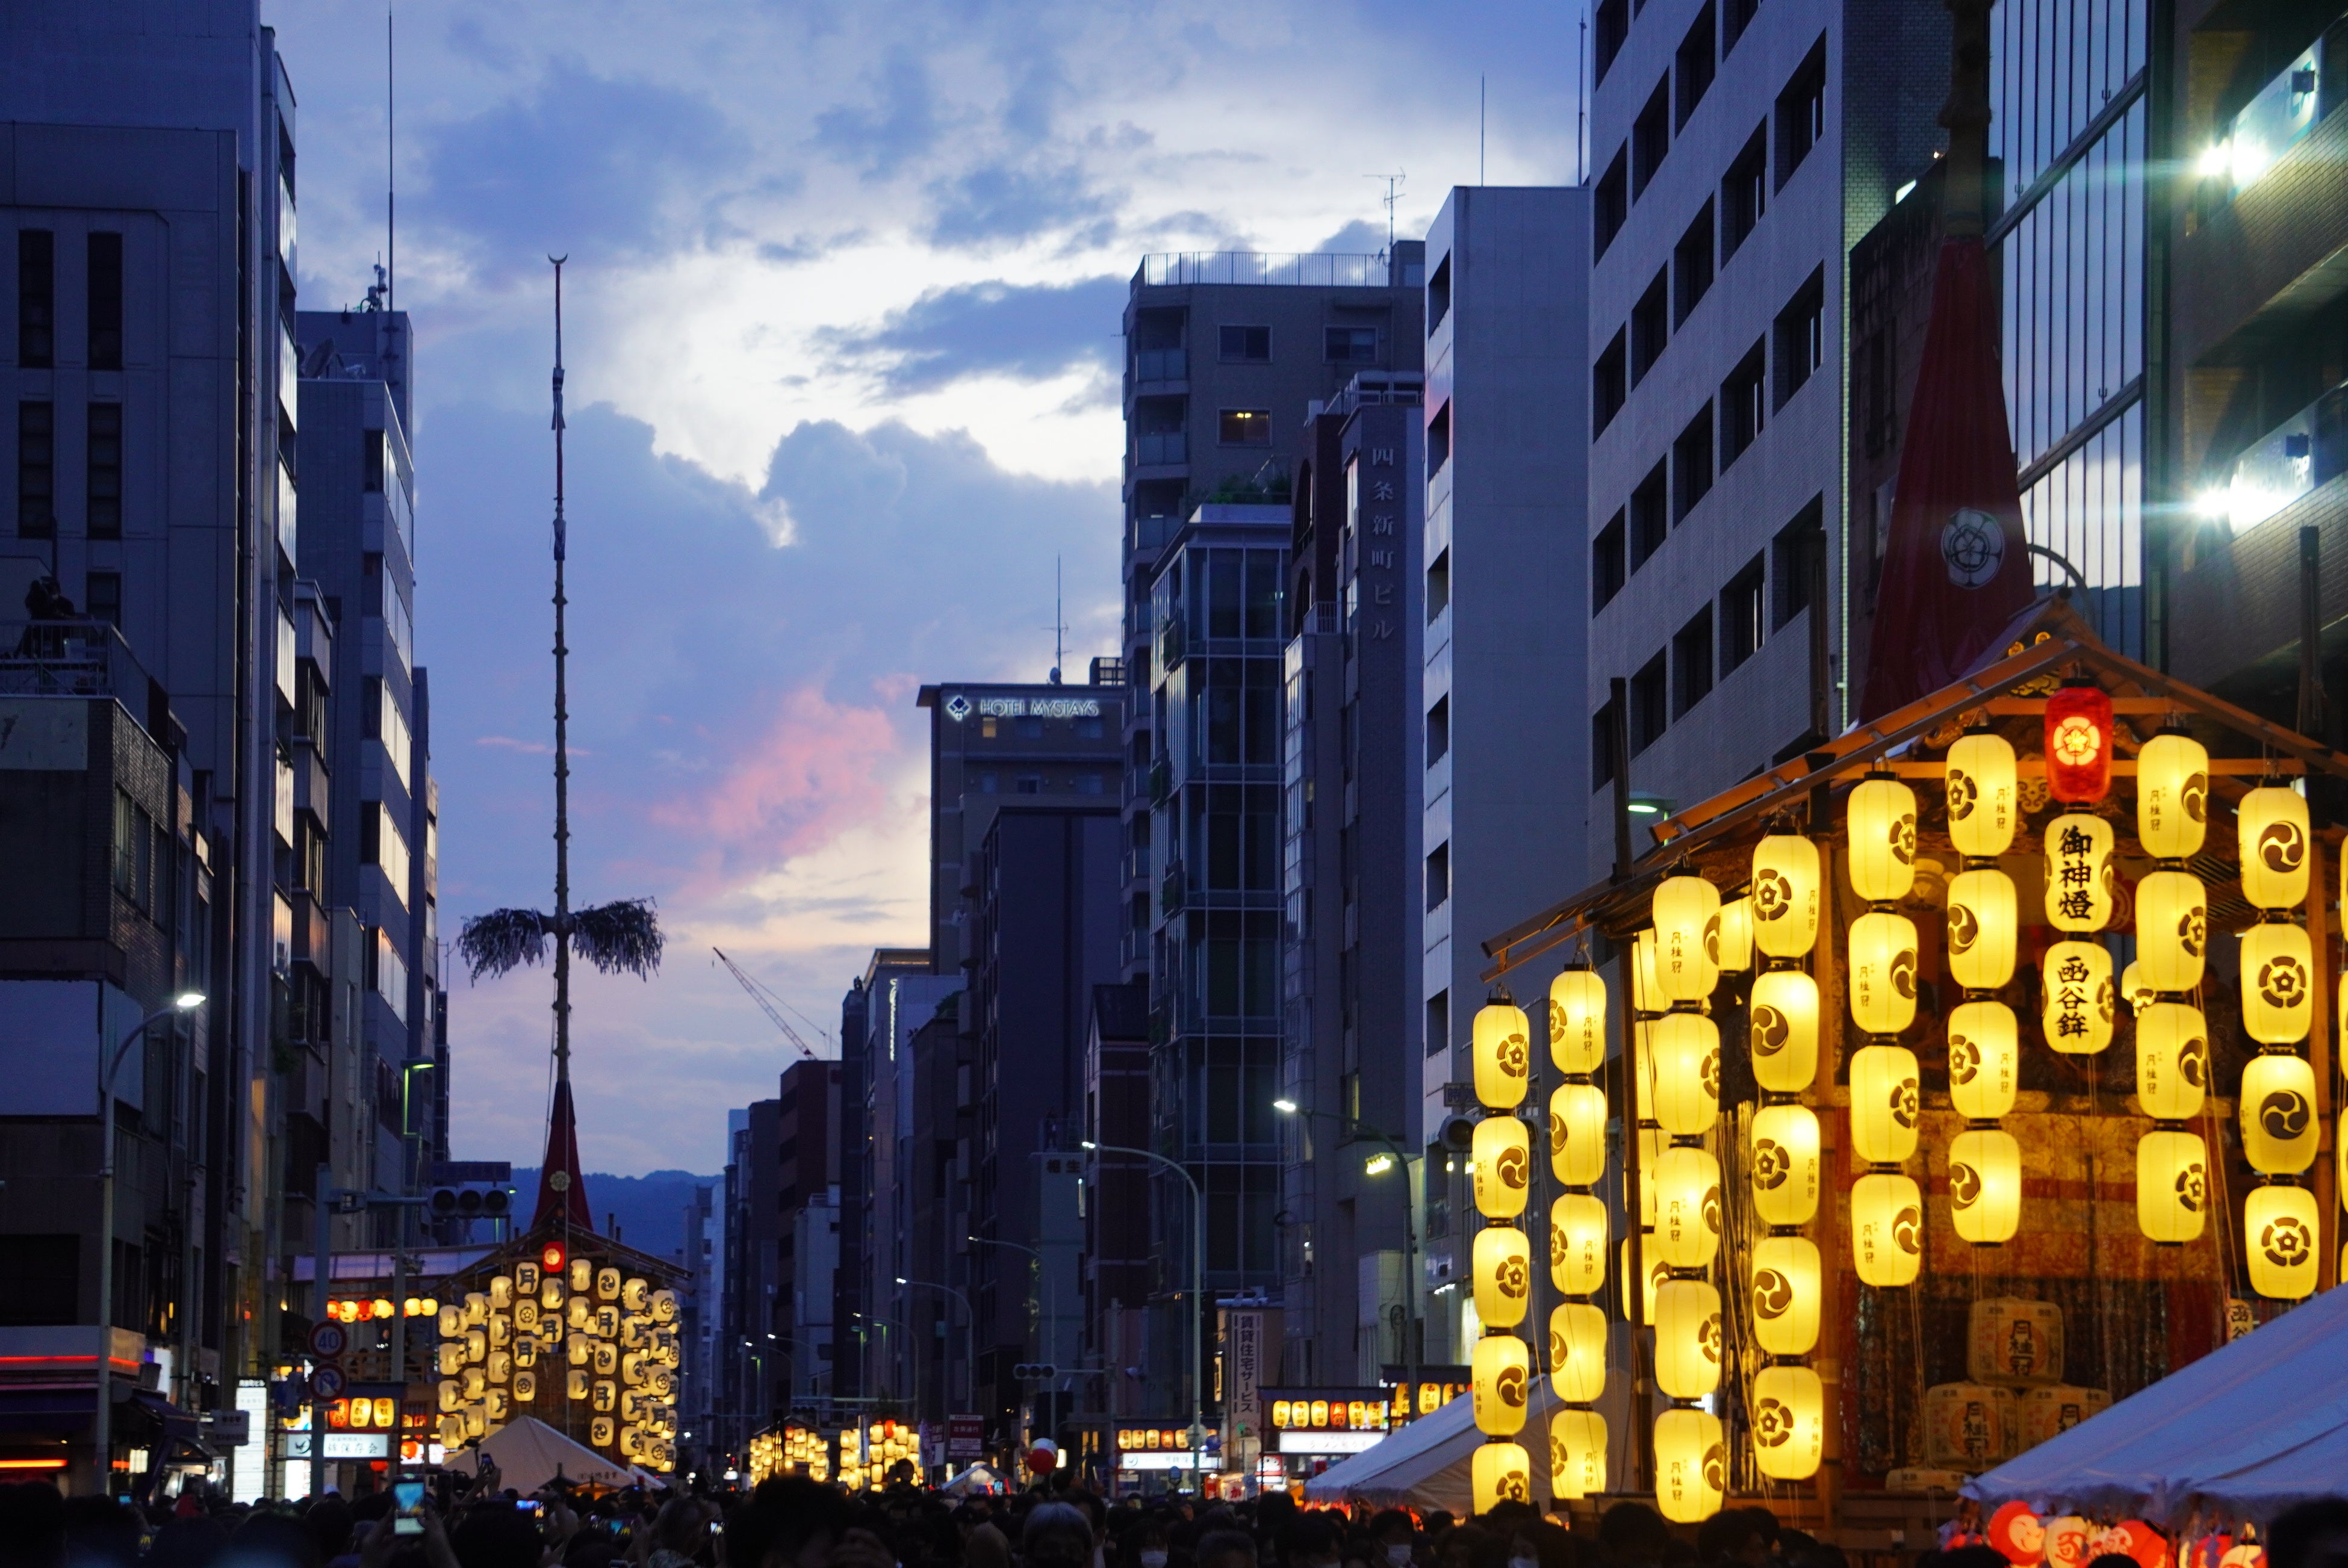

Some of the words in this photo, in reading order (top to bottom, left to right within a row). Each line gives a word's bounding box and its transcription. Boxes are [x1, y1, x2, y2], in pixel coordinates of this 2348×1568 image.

[1371, 448, 1394, 640] 四条新町ビル
[980, 699, 1025, 715] HOTEL
[1030, 699, 1099, 716] MYSTAYS
[2150, 790, 2161, 831] 月桂冠
[2058, 825, 2094, 921] 御神燈
[1671, 932, 1683, 974] 月桂冠
[2055, 955, 2090, 1040] 函谷鉾
[1669, 1201, 1681, 1242] 月桂冠
[520, 1268, 536, 1292] 月
[542, 1319, 559, 1341] 月
[597, 1312, 613, 1334] 月
[318, 1332, 340, 1348] 40
[517, 1340, 534, 1364] 月
[656, 1333, 672, 1356] 月
[1240, 1315, 1254, 1412] 賃貸住宅サービス
[594, 1386, 610, 1408] 月
[1671, 1461, 1683, 1501] 月桂冠
